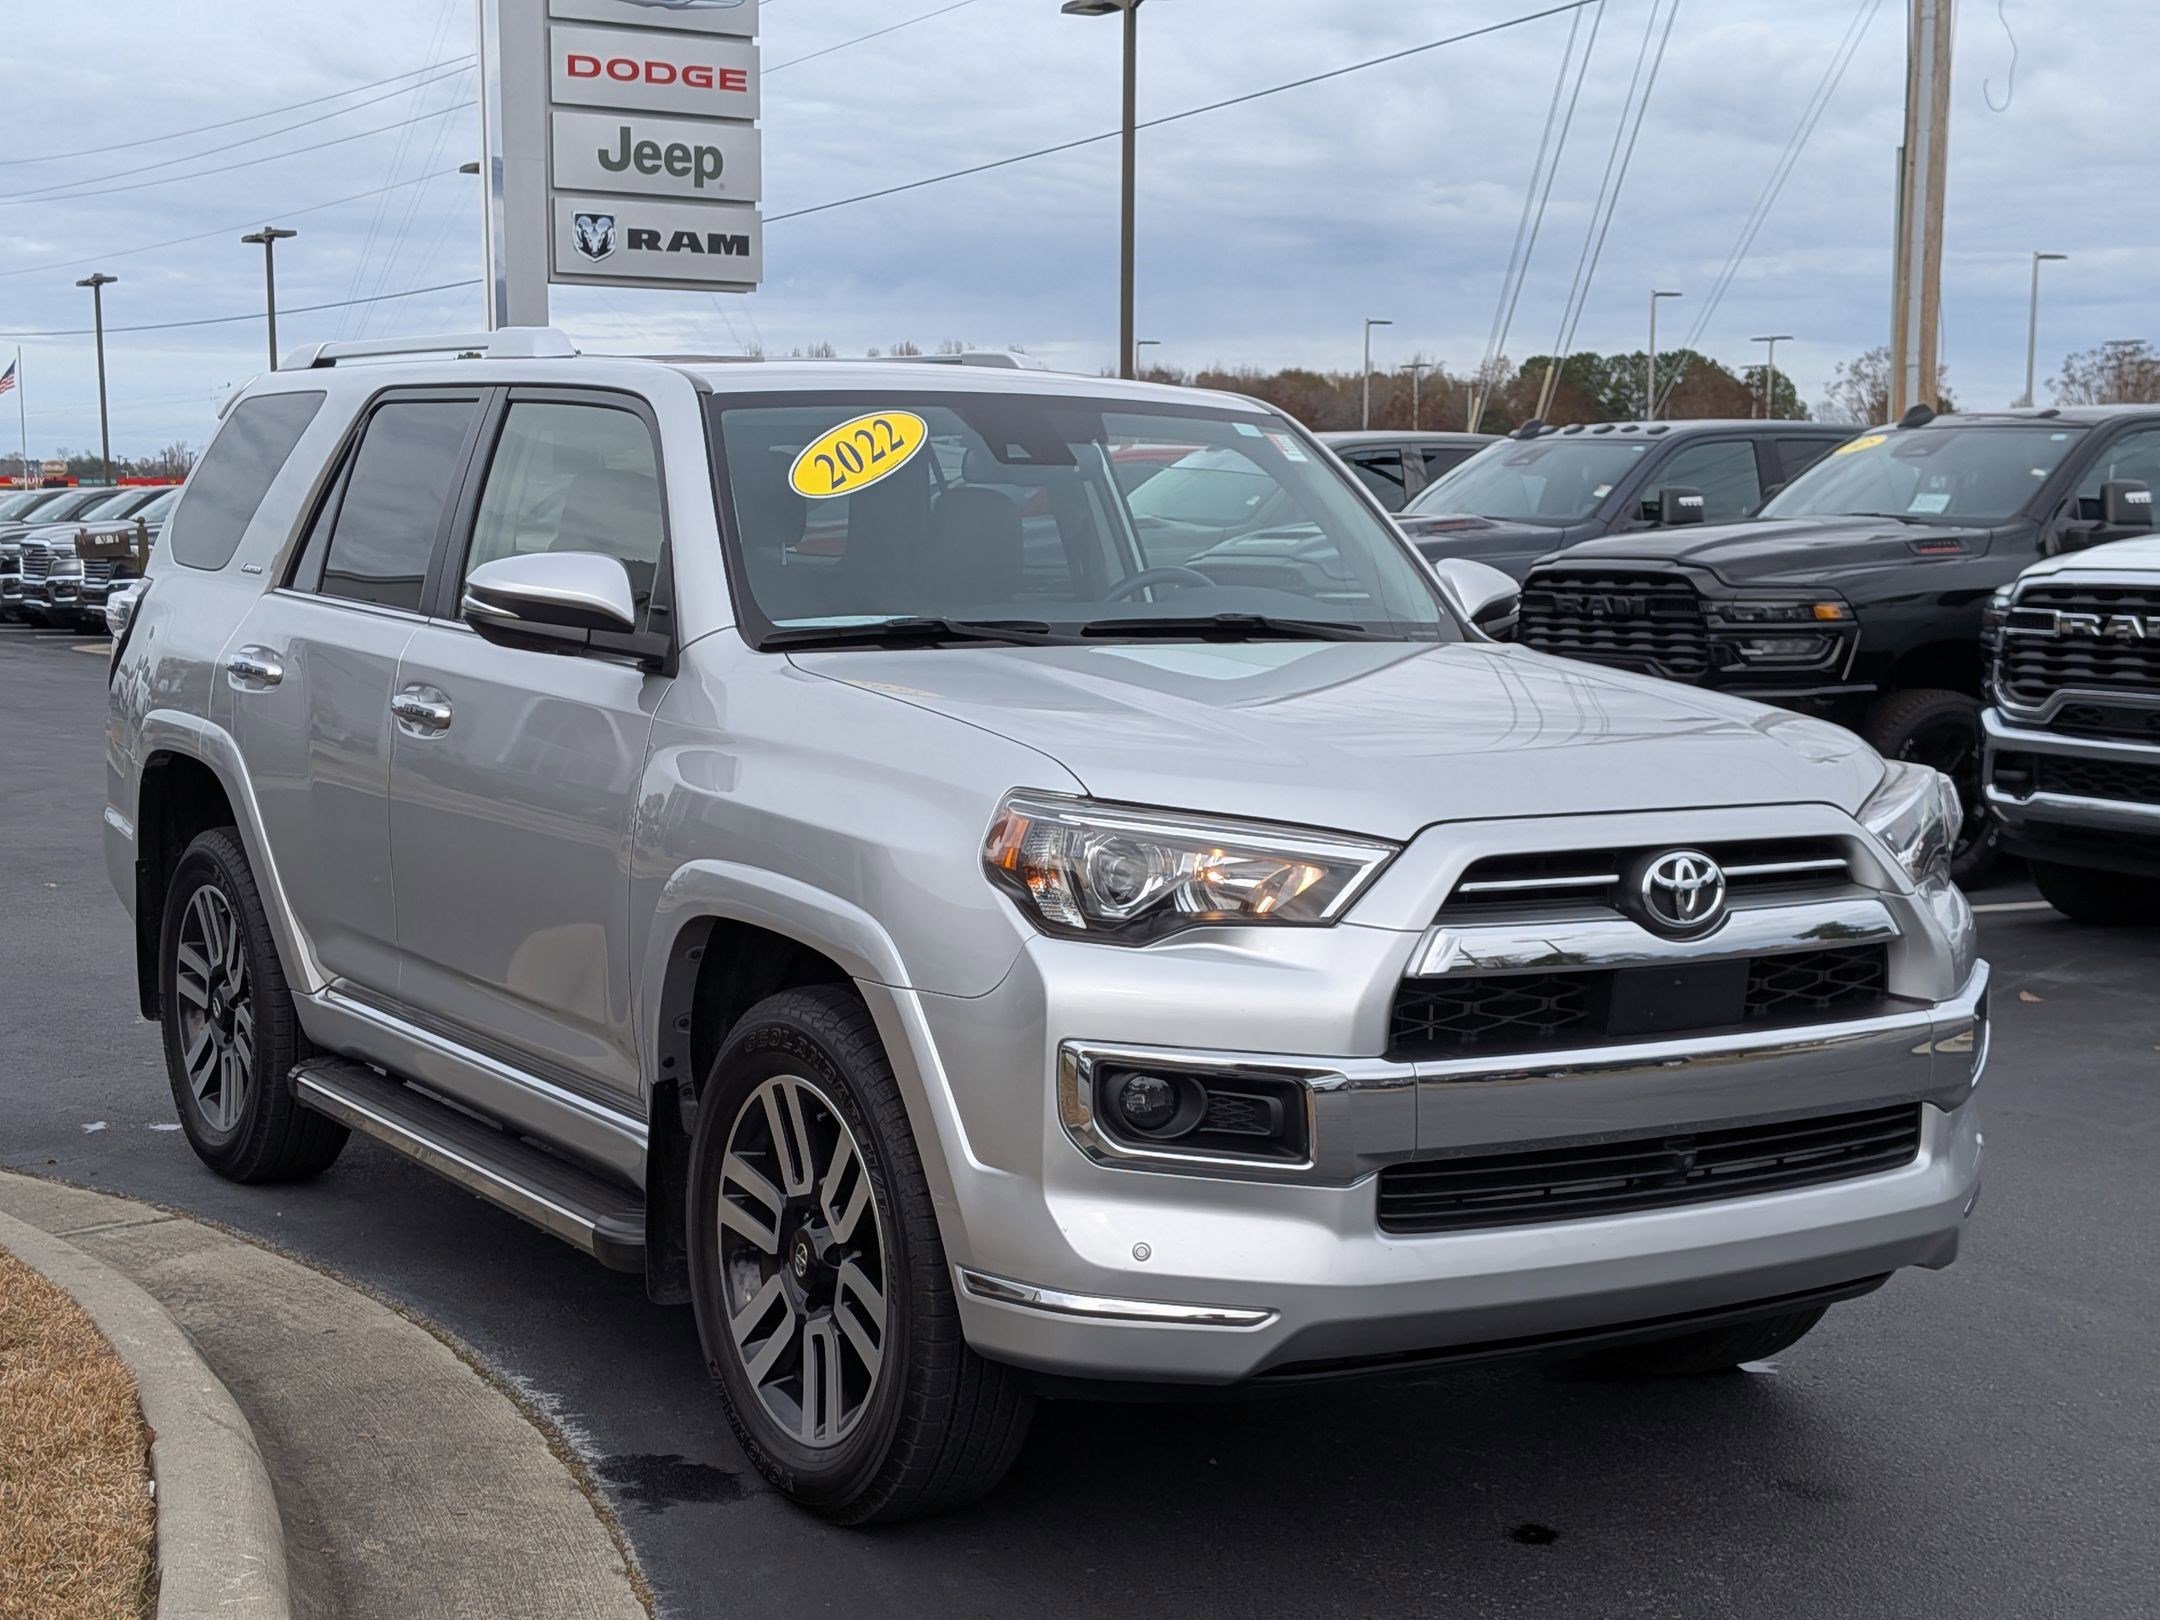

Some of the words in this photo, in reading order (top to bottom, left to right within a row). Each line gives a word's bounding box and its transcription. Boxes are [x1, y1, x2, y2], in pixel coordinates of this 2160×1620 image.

[567, 54, 747, 93] DODGE
[597, 126, 724, 189] Jeep
[627, 228, 750, 257] RAM
[814, 419, 905, 490] 2022
